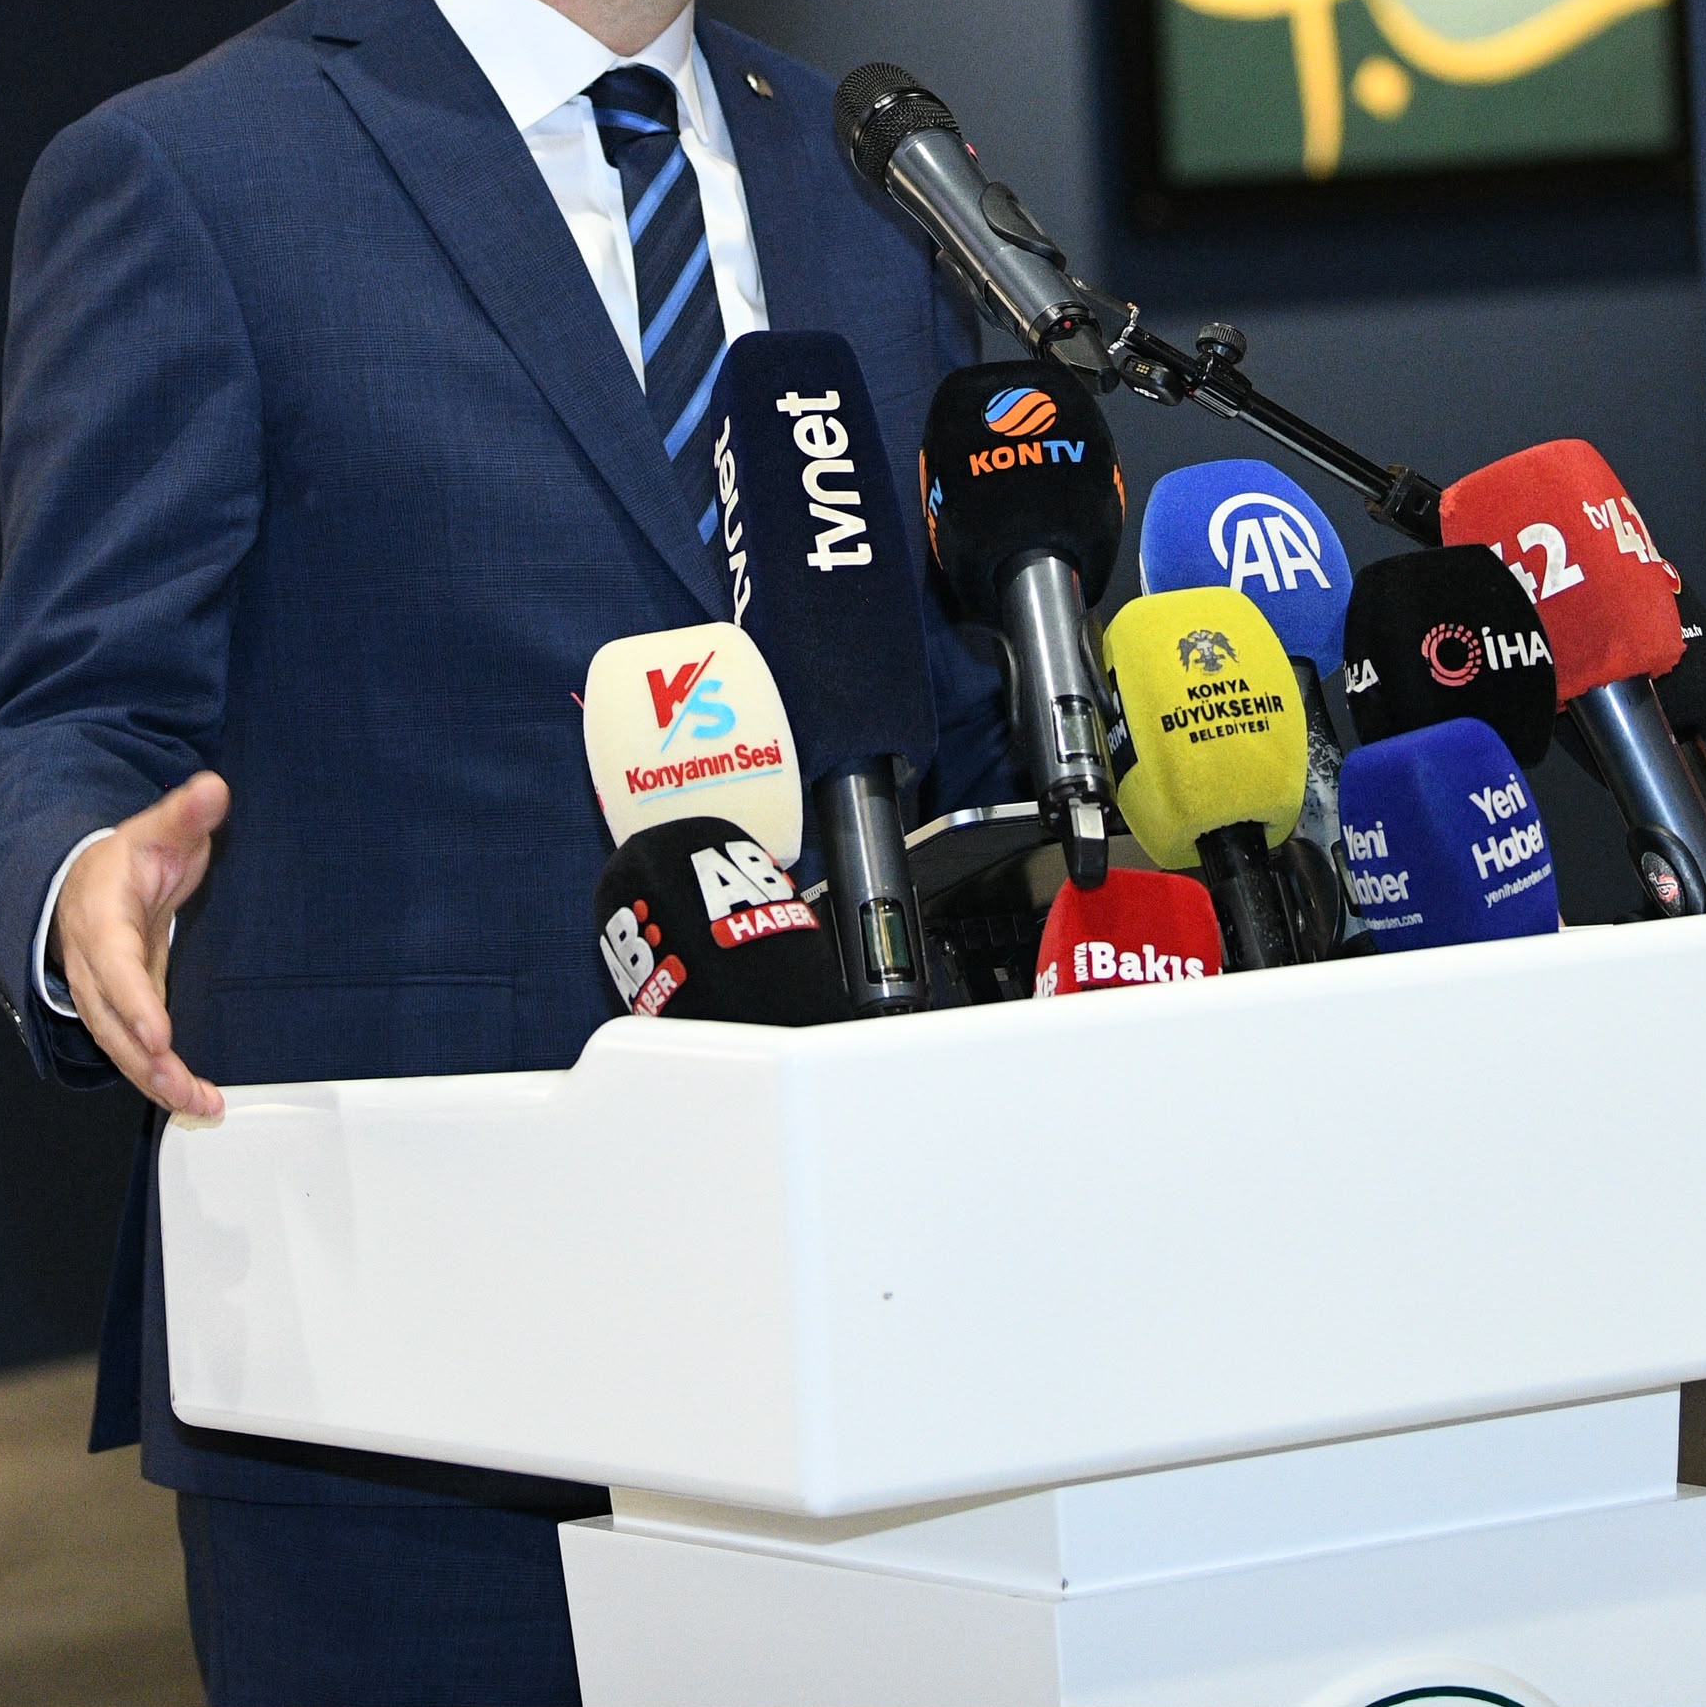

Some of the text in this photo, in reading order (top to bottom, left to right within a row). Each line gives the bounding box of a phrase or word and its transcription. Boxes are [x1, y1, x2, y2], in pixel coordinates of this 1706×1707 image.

[969, 440, 1085, 476] KONTV
[776, 390, 873, 572] tvnet
[1228, 513, 1333, 593] AA
[1481, 626, 1554, 671] İHA
[1187, 678, 1250, 702] KONYA
[1189, 718, 1271, 744] BELEDİYESİ
[734, 739, 783, 771] Sesi
[1468, 773, 1528, 826] Yeni
[1471, 819, 1545, 881] Haber
[691, 840, 794, 922] AB
[726, 903, 816, 941] HABER
